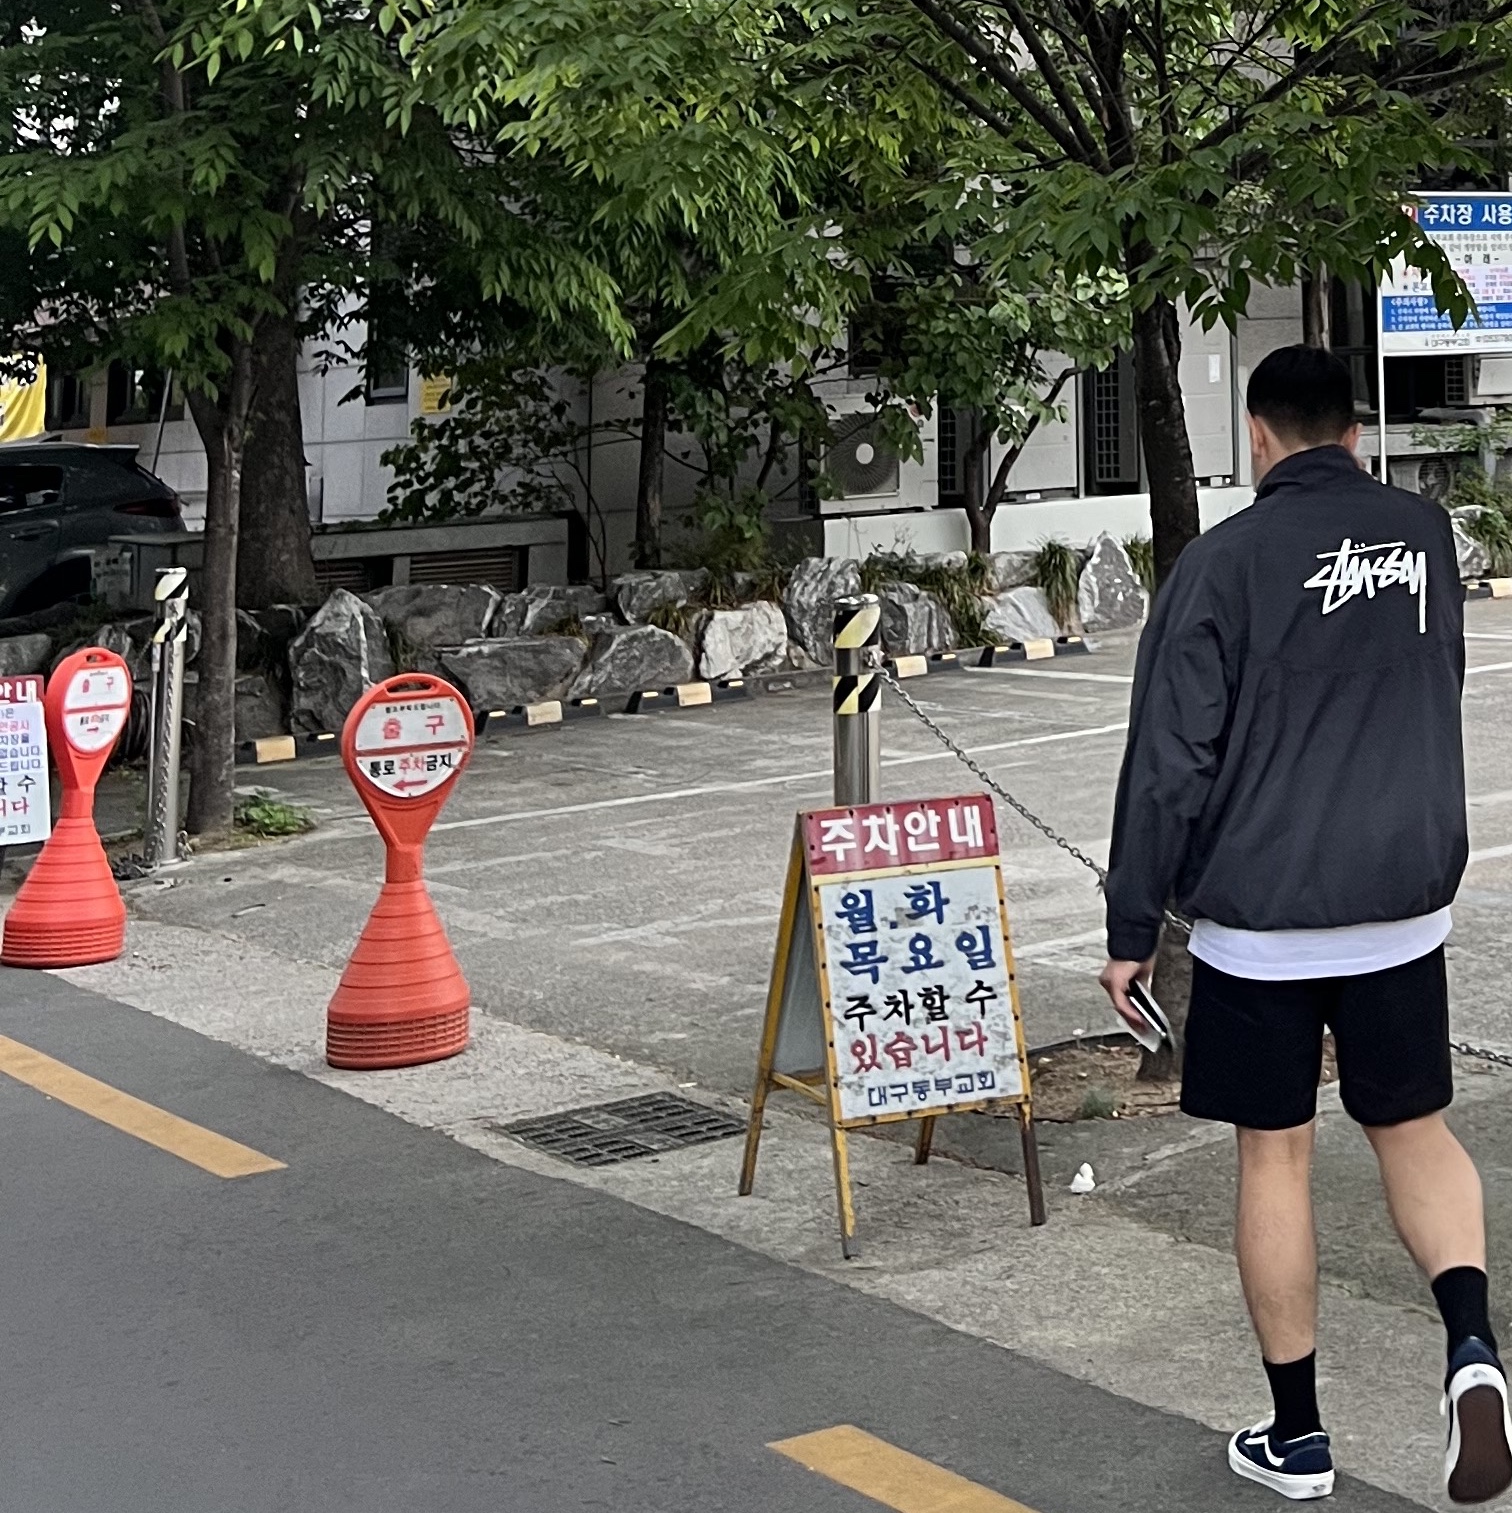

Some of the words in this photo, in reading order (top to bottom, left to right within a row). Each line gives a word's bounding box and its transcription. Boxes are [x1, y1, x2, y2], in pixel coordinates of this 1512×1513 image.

[1423, 204, 1474, 225] 주차장
[1481, 204, 1512, 225] 사용
[17, 775, 36, 793] 수
[819, 805, 985, 862] 주차안내
[843, 984, 951, 1032] 주차할
[965, 980, 998, 1016] 수
[850, 1021, 989, 1074] 있습니다
[868, 1070, 996, 1108] 대구동부교회
